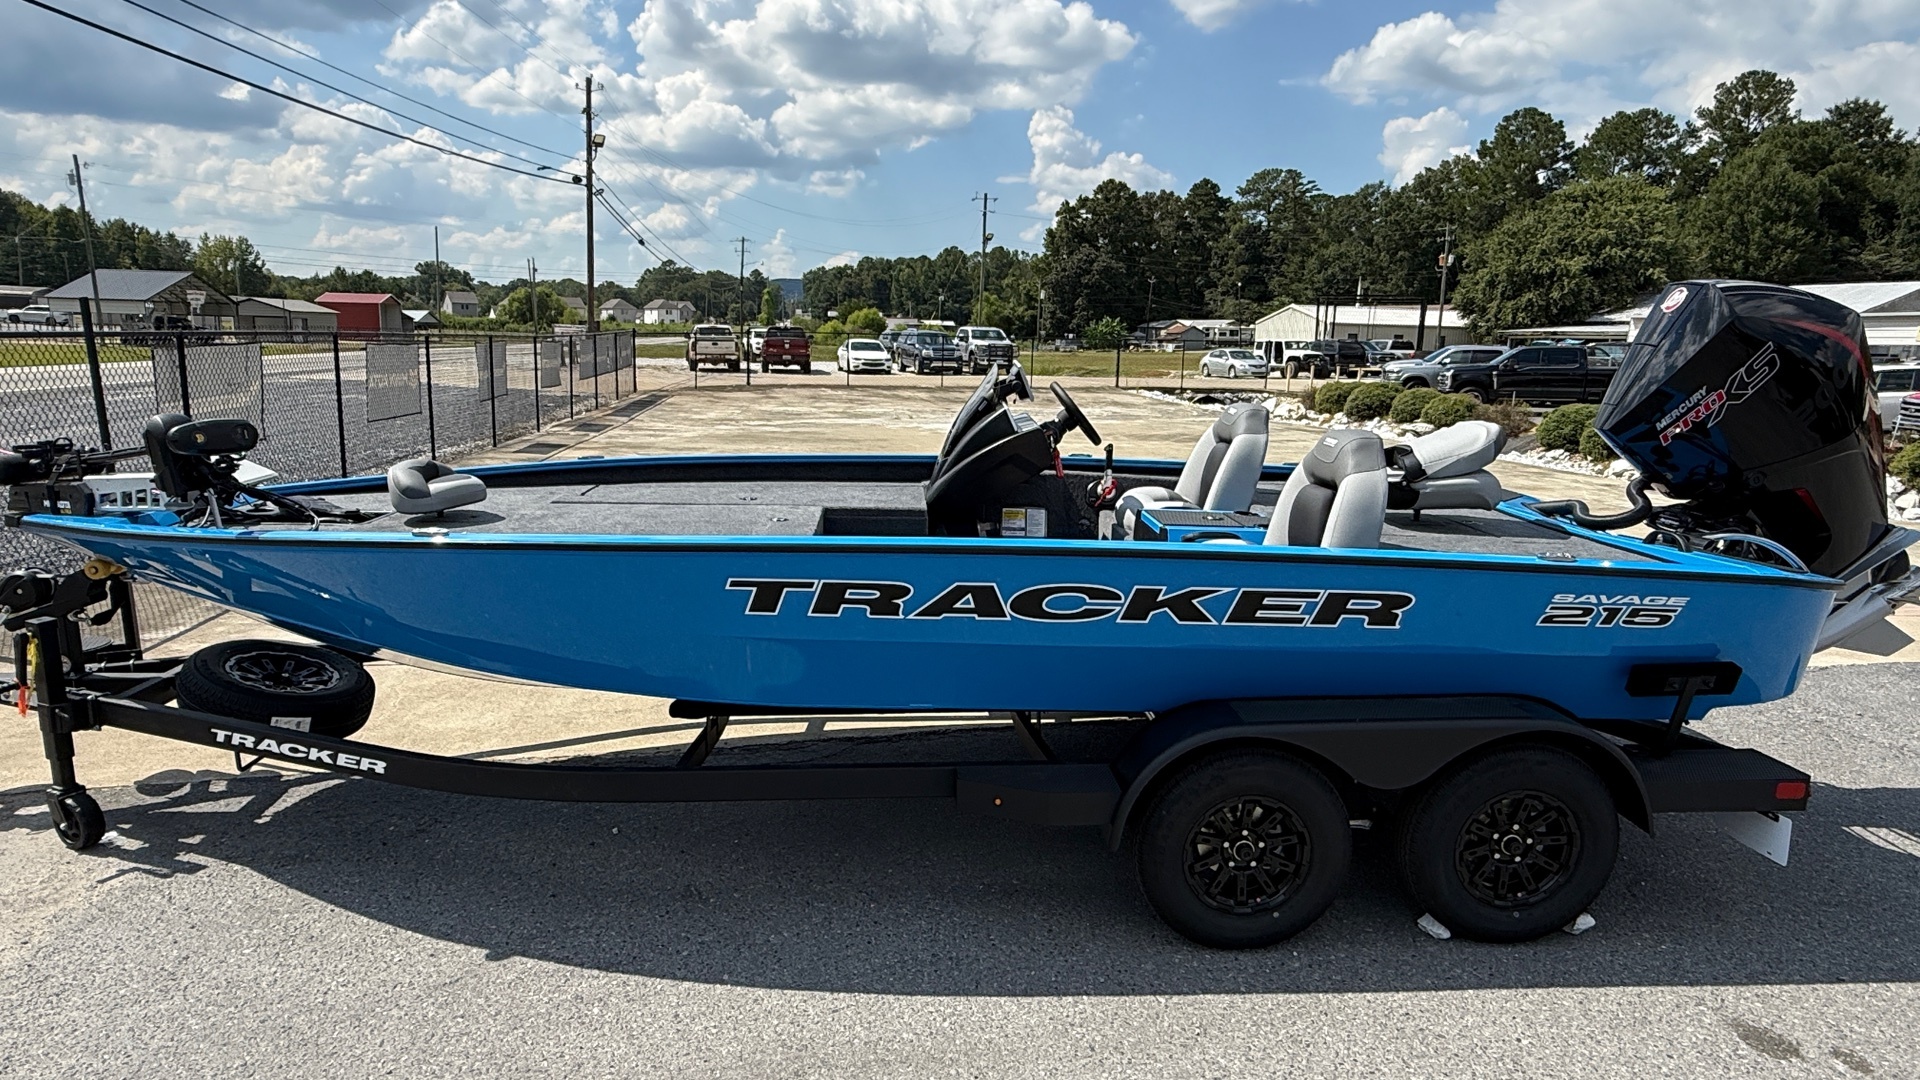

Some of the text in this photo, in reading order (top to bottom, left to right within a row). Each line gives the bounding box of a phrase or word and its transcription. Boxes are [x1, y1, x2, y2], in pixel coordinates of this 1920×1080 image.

[1656, 385, 1707, 431] MERCURY
[725, 578, 1416, 629] TRACKER
[1535, 604, 1683, 628] 215
[1551, 594, 1691, 606] SAVAGE
[210, 728, 388, 775] TRACKER
